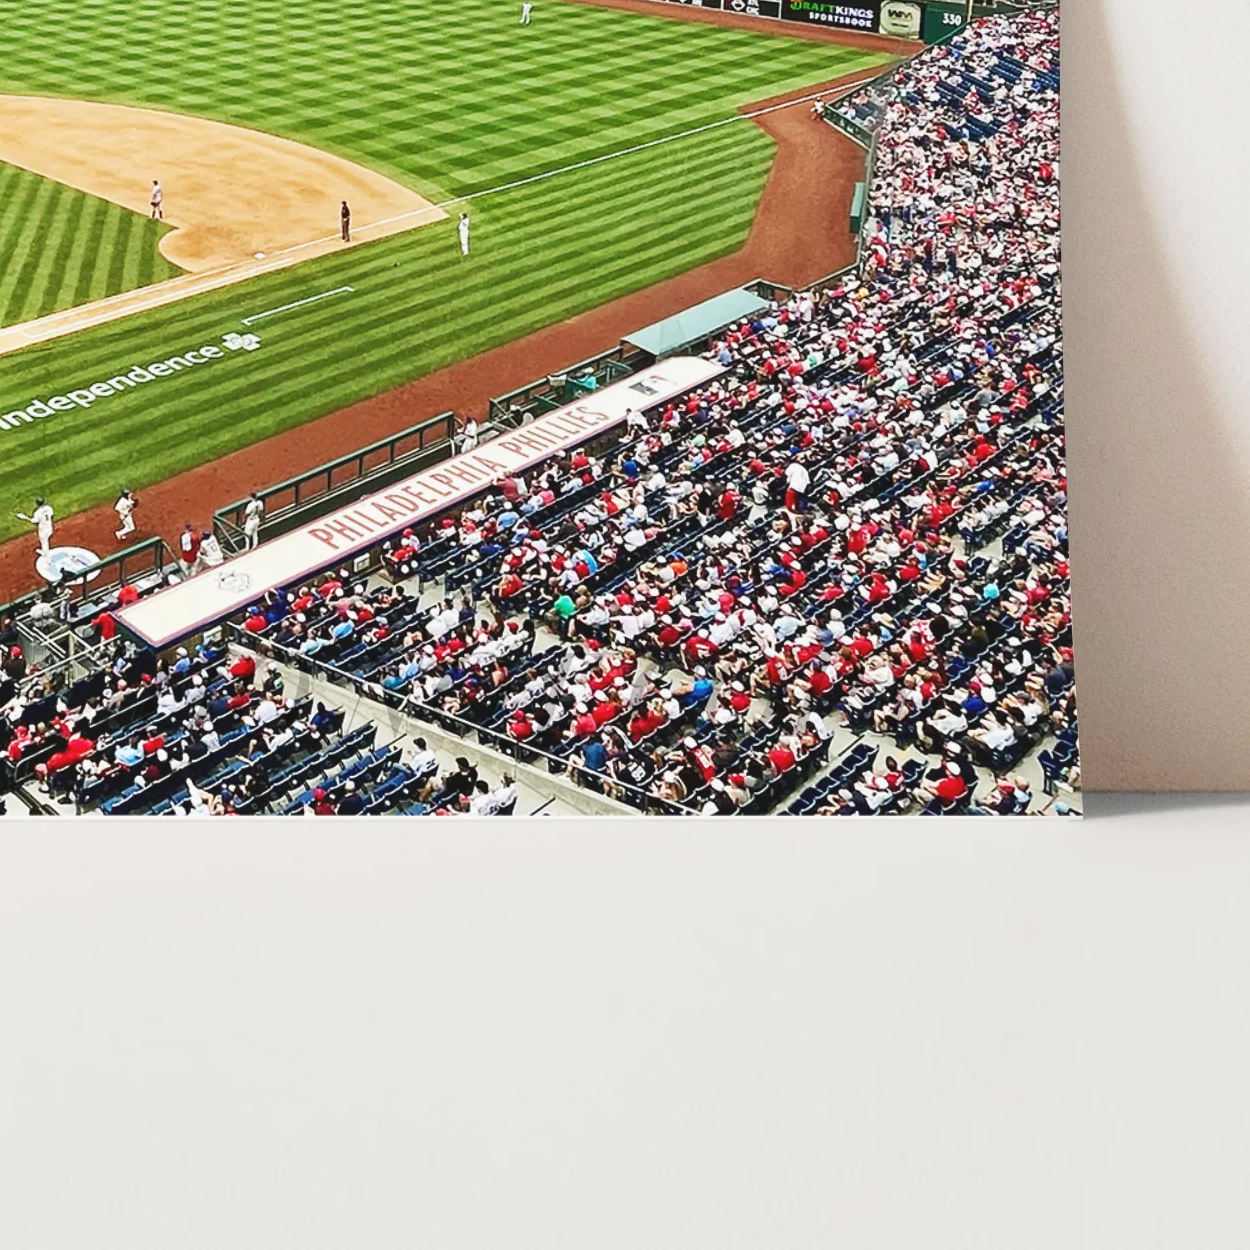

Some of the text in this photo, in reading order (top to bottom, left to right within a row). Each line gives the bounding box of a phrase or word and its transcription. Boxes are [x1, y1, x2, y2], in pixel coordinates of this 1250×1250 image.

[809, 11, 872, 28] SPORTSBOOK
[942, 12, 962, 26] 330
[307, 405, 610, 551] PHILADELPHIA PHILLIES
